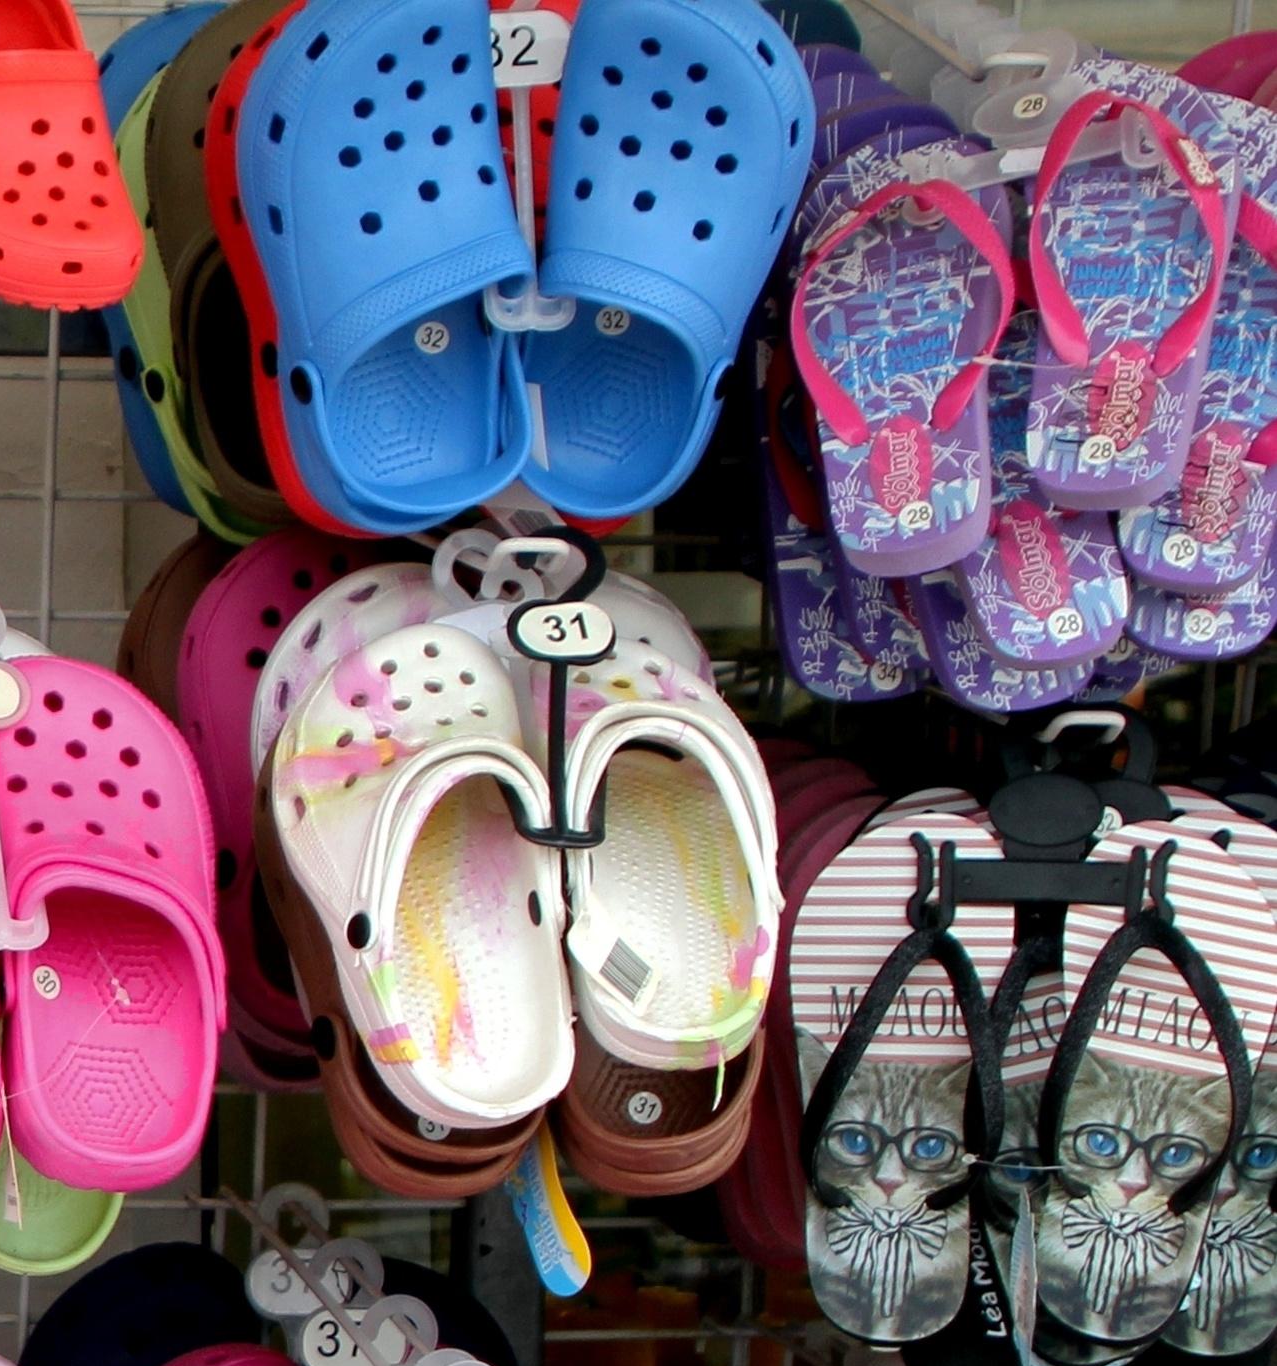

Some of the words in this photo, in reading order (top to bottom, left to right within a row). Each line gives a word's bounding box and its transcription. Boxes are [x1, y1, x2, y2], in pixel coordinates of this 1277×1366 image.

[1022, 98, 1045, 114] 28
[602, 310, 625, 330] 32
[421, 326, 445, 349] 32
[1087, 442, 1112, 459] 28
[883, 430, 917, 511] Solmar
[906, 505, 931, 525] 28
[1170, 541, 1195, 561] 28
[1020, 516, 1061, 611] Solmar
[542, 612, 589, 643] 31
[1055, 614, 1081, 634] 28
[1189, 613, 1214, 635] 32
[36, 970, 57, 994] 30
[634, 1096, 658, 1119] 31
